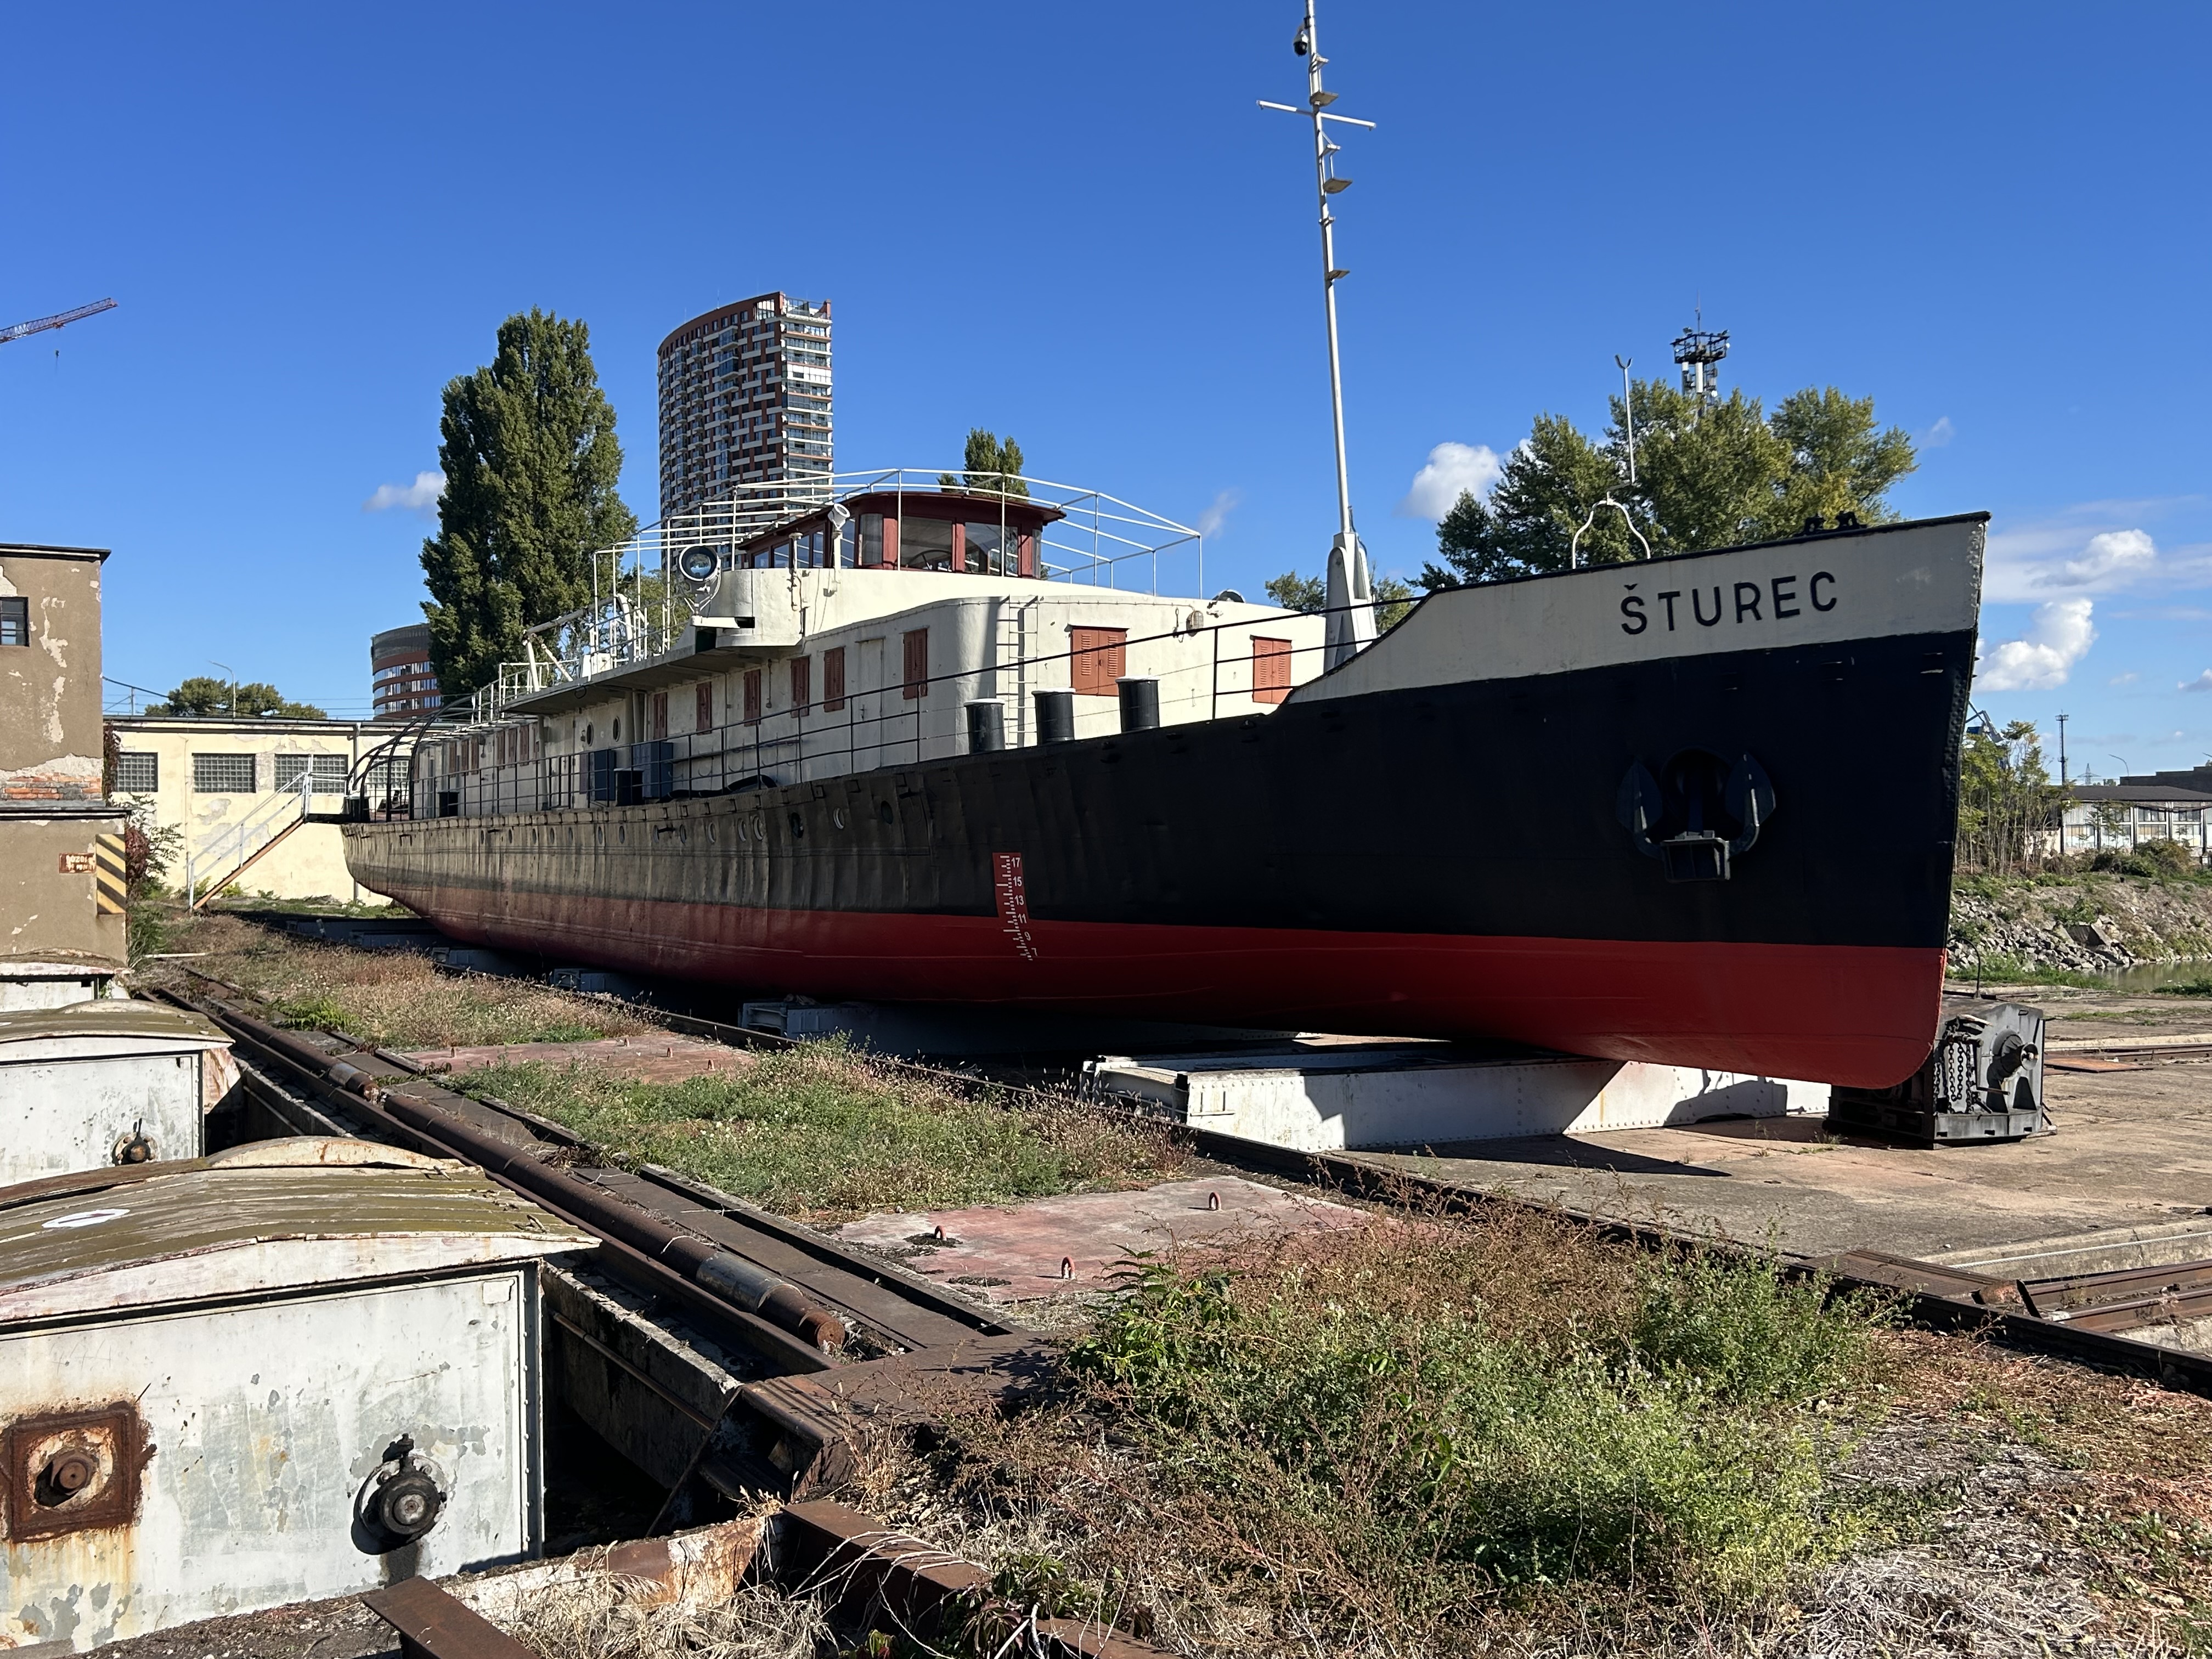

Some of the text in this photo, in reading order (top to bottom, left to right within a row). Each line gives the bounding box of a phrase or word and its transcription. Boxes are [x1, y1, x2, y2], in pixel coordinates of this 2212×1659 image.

[1620, 571, 1838, 635] ŠTUREC
[1011, 857, 1020, 868] 17
[1013, 876, 1023, 887] 15
[1014, 895, 1024, 905] 13
[1018, 913, 1027, 923] 11
[1024, 932, 1031, 941] 9
[1031, 947, 1038, 956] 7
